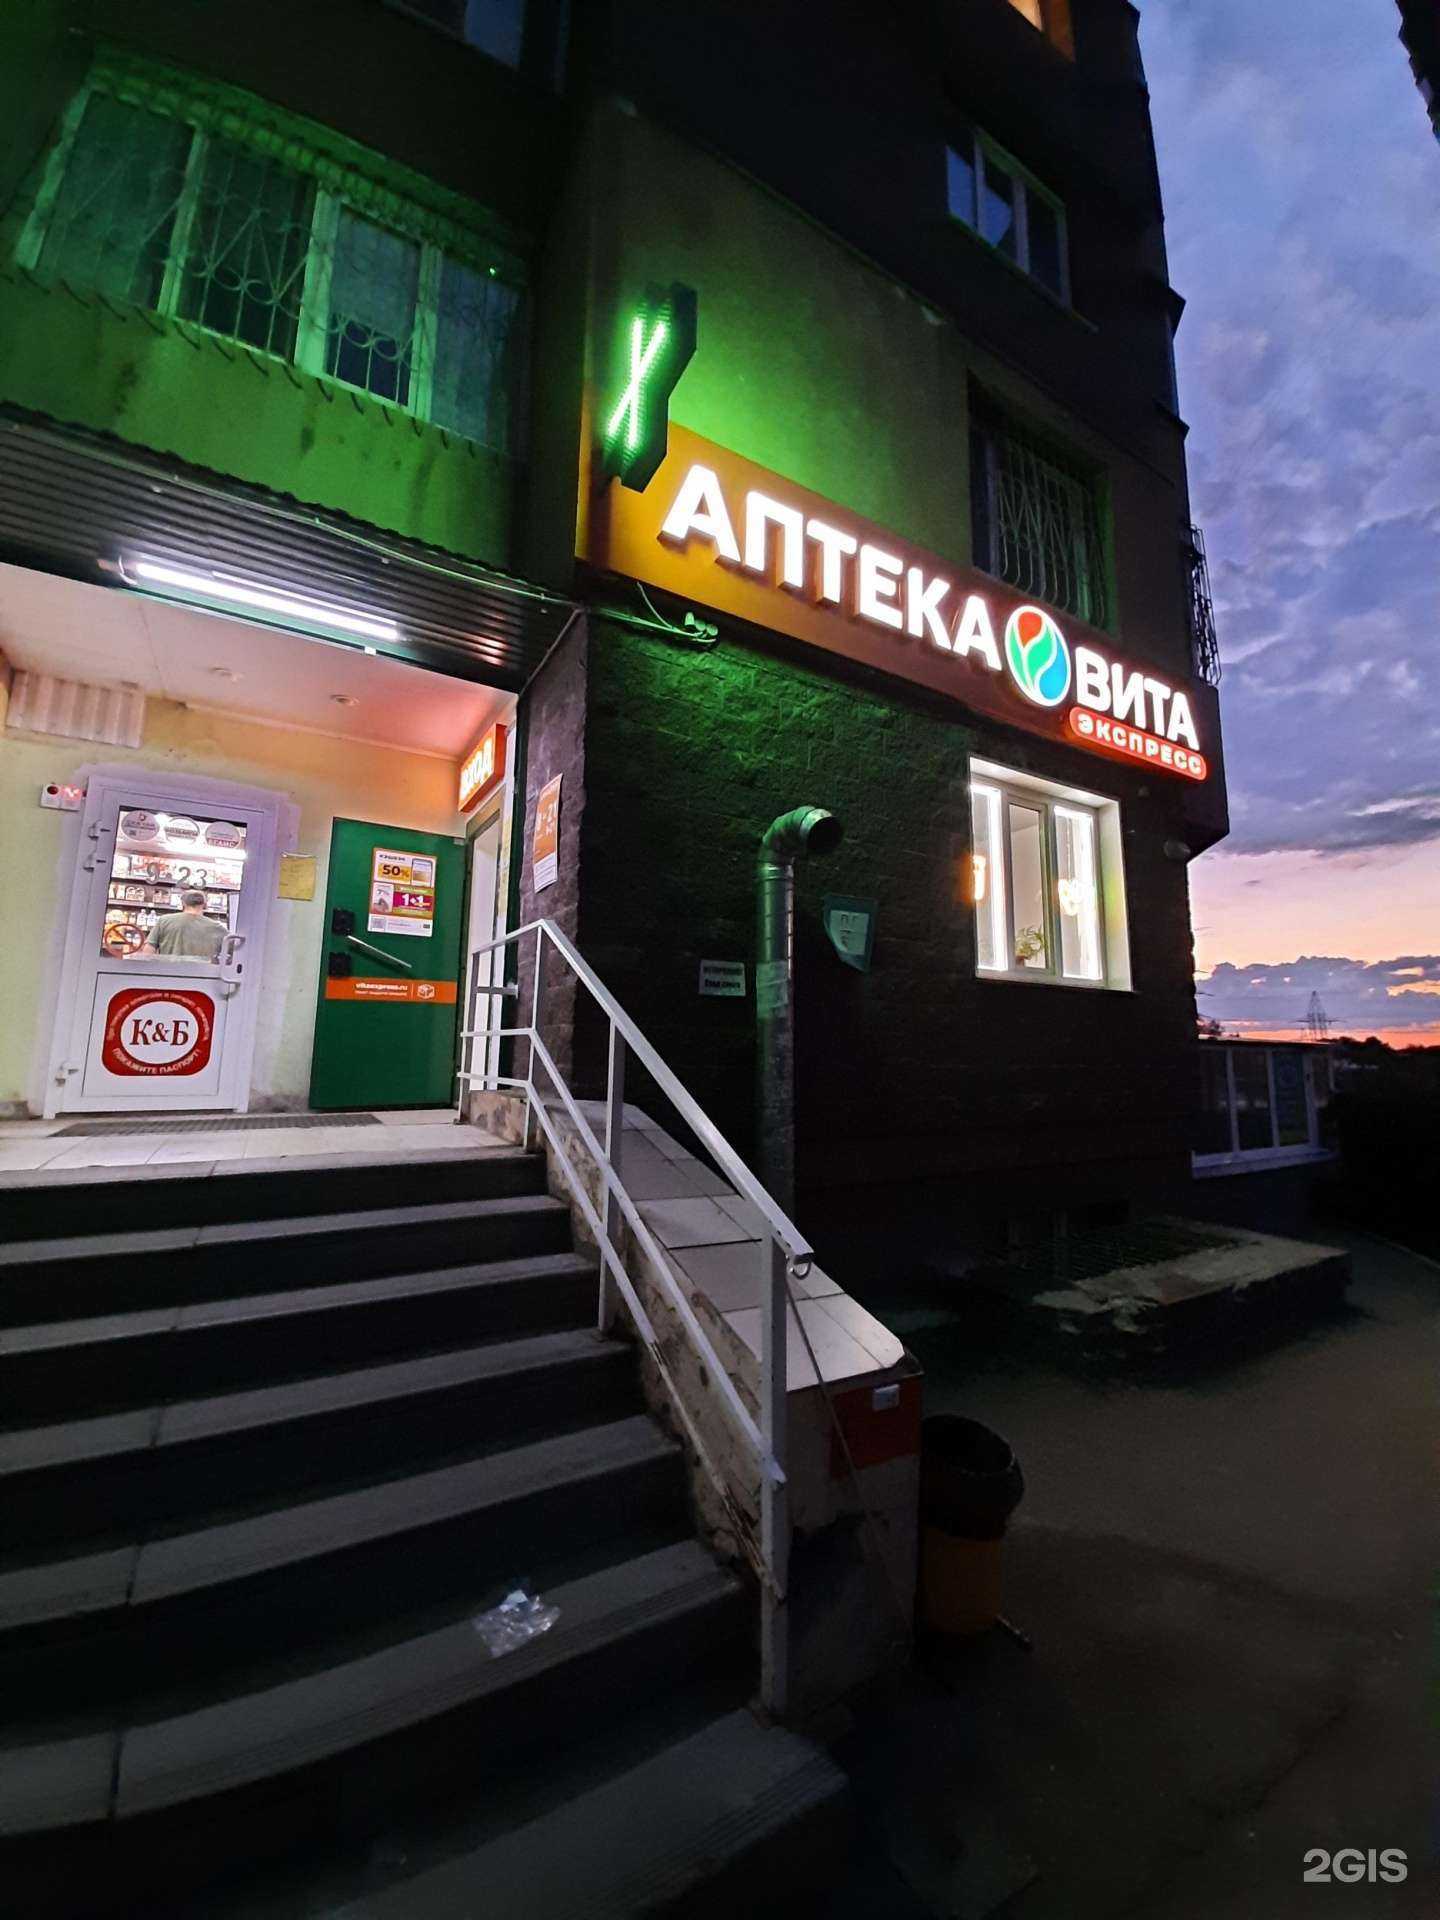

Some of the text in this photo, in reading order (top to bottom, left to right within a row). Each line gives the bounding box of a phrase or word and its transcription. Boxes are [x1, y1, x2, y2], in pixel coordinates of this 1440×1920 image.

[659, 464, 1200, 751] АПТЕКА ВИТА
[1077, 712, 1202, 775] ЭКСПРЕСС
[175, 866, 208, 890] 23
[382, 864, 410, 877] 50%
[129, 1018, 189, 1046] К&Б
